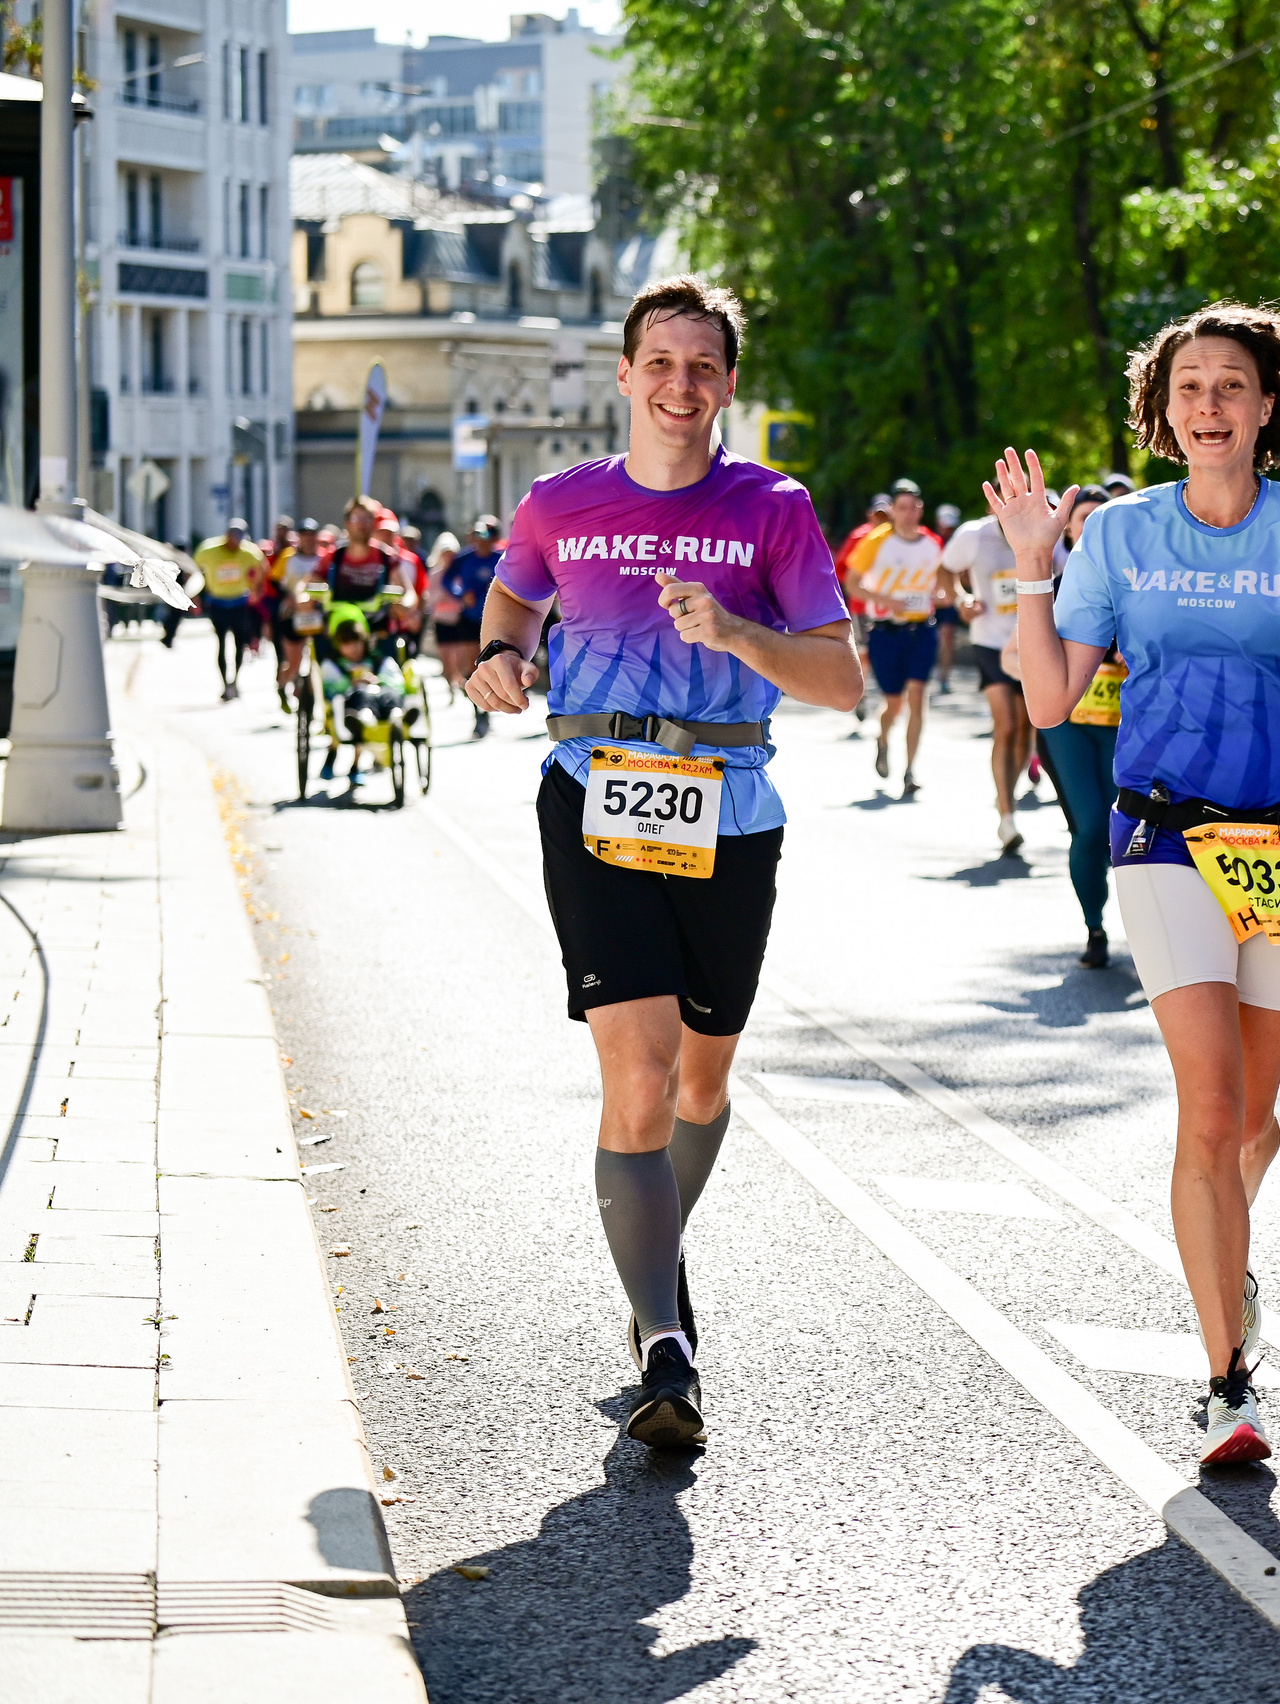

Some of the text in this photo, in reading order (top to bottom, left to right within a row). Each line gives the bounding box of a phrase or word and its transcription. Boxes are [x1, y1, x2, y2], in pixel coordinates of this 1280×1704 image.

[619, 566, 677, 576] MOSCOW
[1177, 597, 1236, 609] MOSCOW
[627, 759, 713, 775] МОСКВА 42,2 КМ
[603, 779, 703, 824] 5230
[637, 822, 665, 835] ОЛЕГ
[1219, 828, 1271, 837] МАРАФОН
[597, 839, 611, 856] F
[1220, 836, 1261, 846] МОСКВА
[1237, 907, 1261, 932] H
